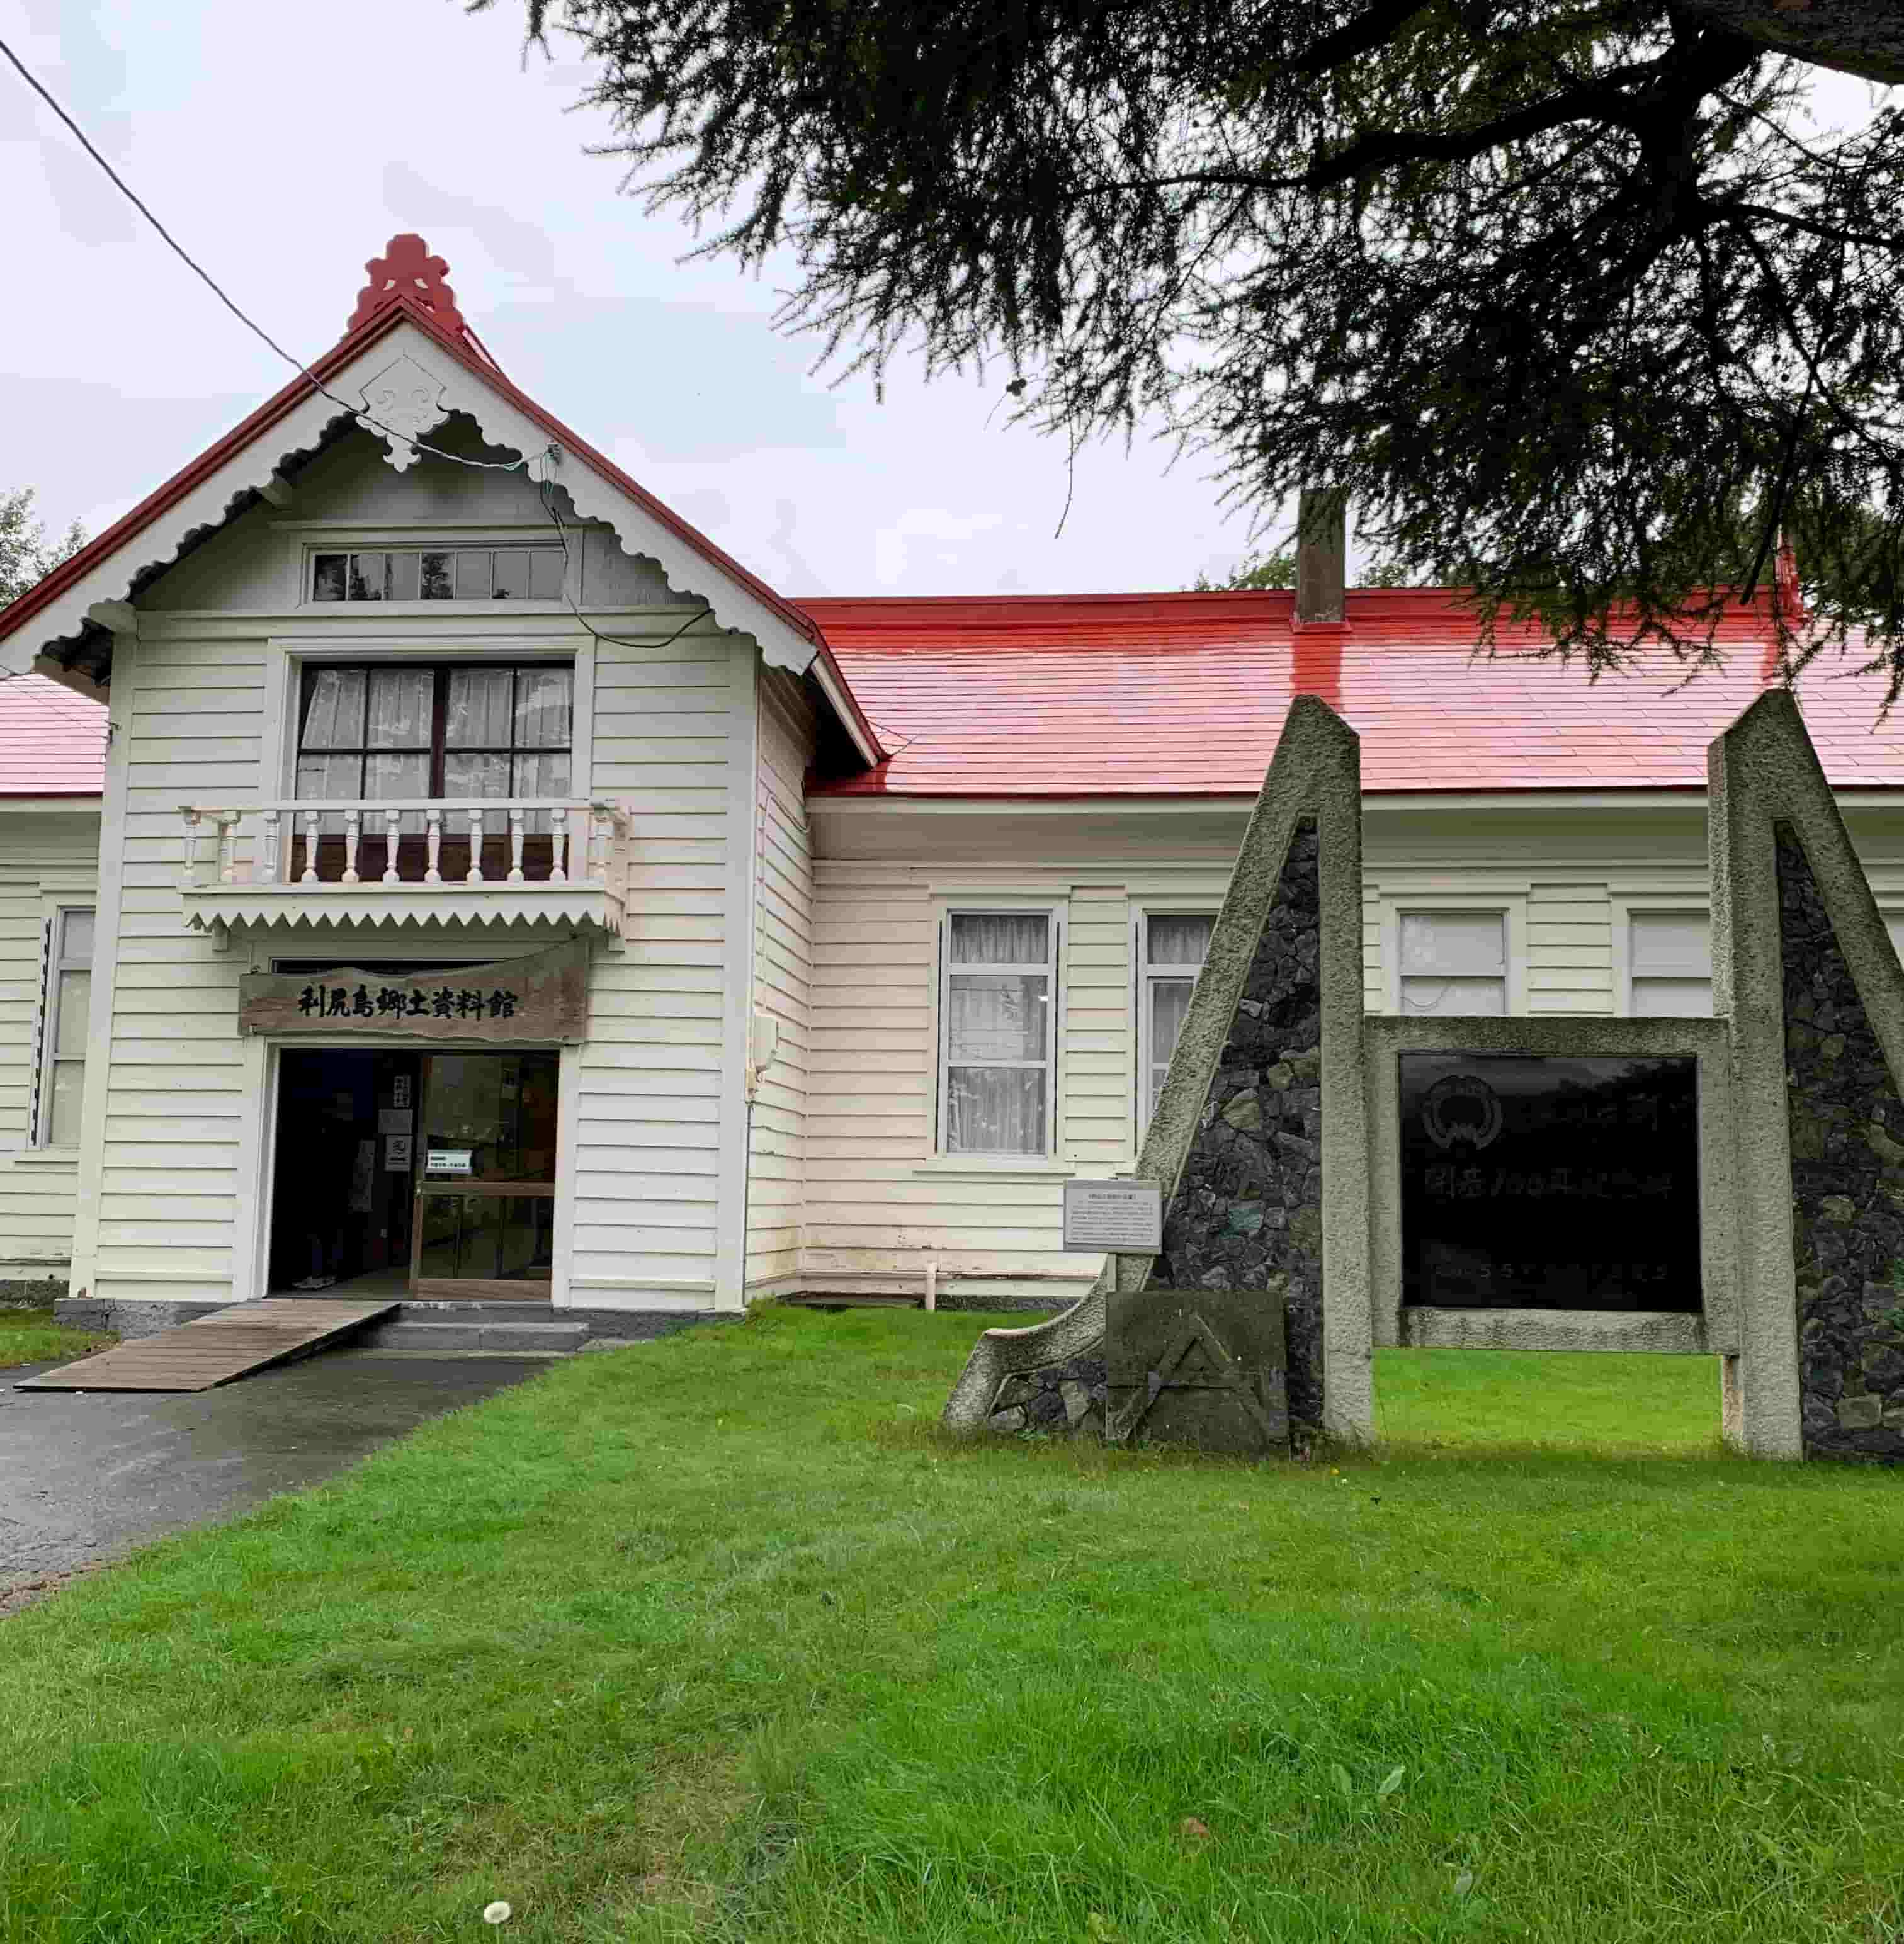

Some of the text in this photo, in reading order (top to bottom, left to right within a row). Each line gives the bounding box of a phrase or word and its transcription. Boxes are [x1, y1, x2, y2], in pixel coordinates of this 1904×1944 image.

[298, 984, 518, 1021] 利尻島郷土資料館
